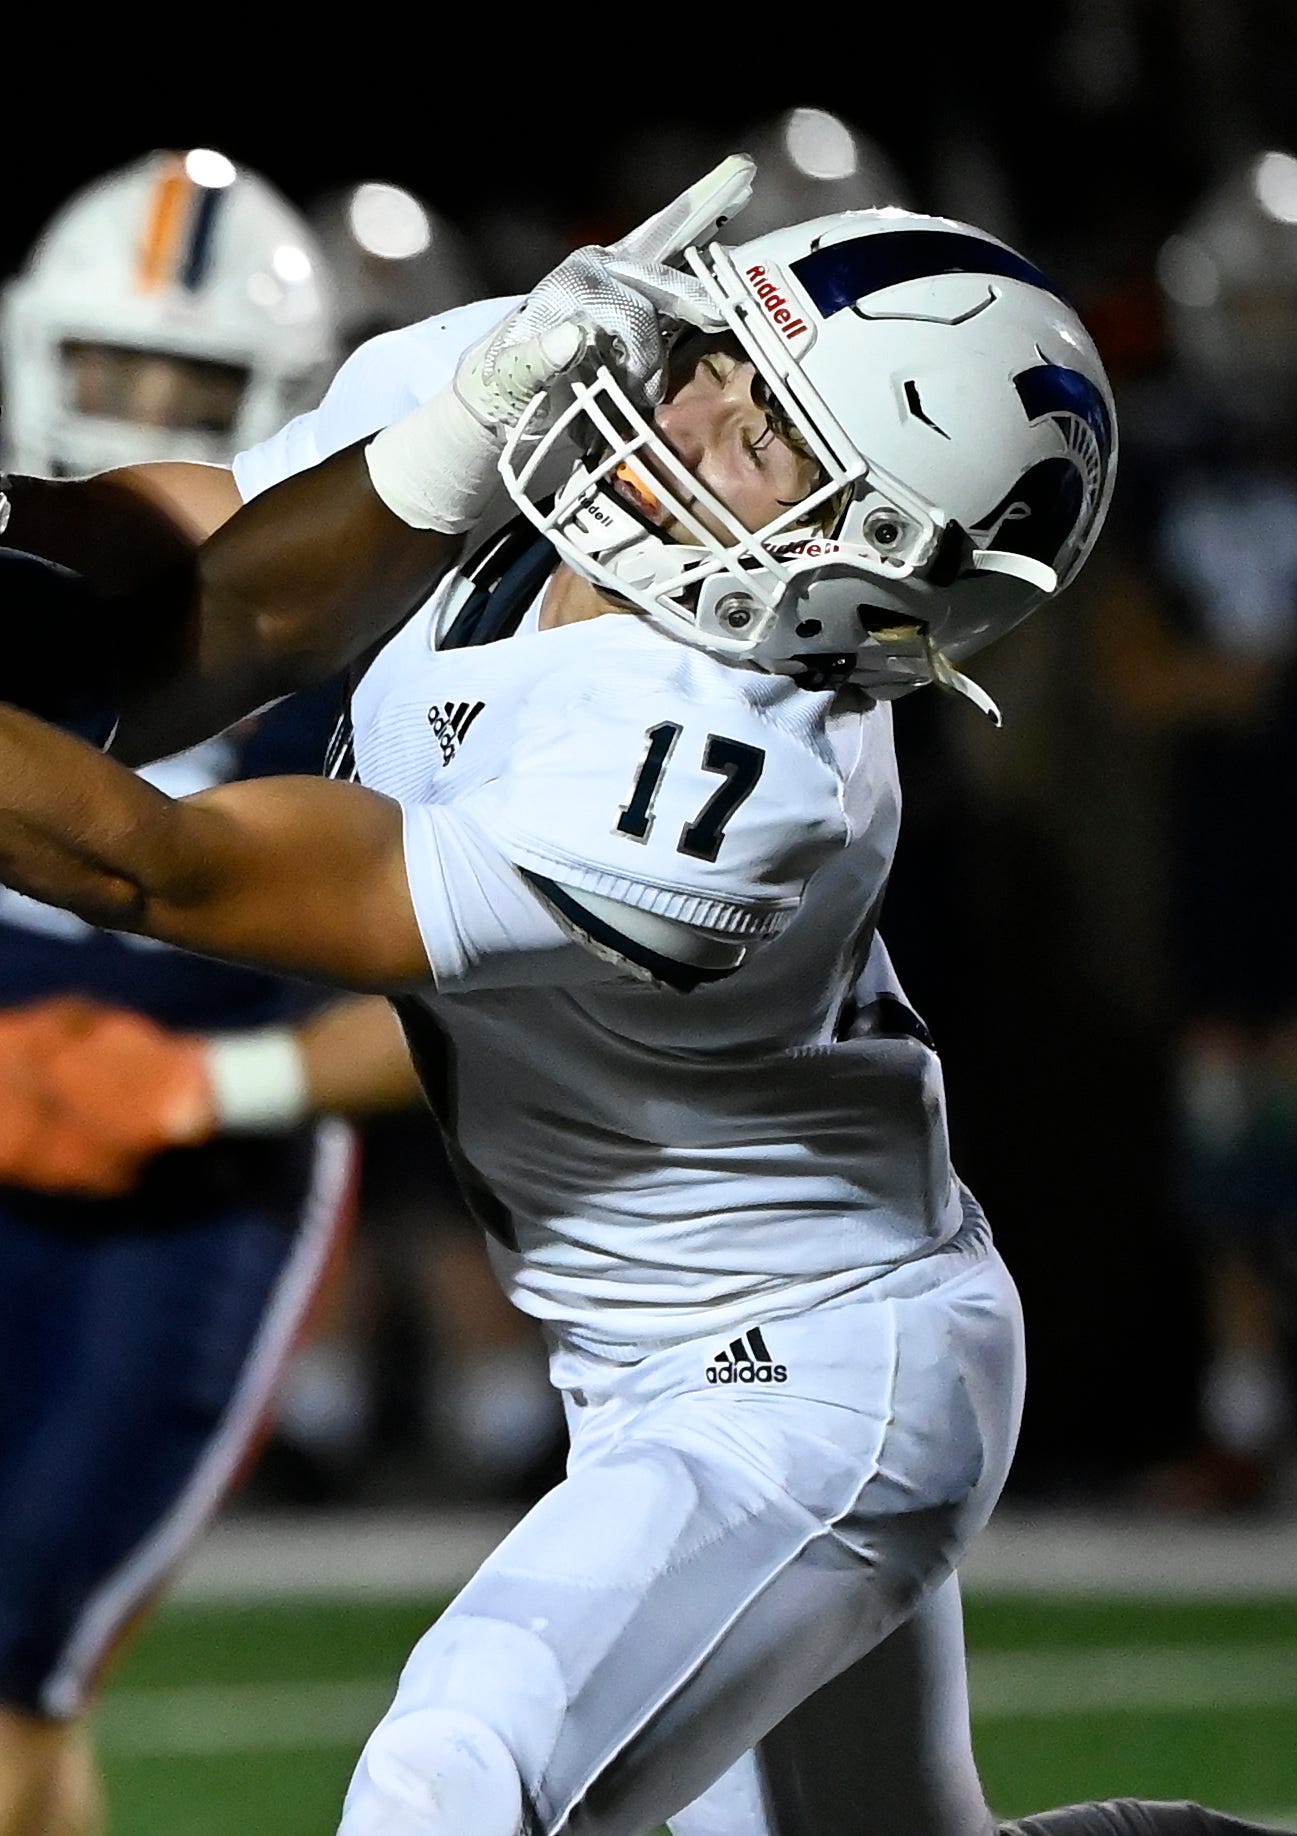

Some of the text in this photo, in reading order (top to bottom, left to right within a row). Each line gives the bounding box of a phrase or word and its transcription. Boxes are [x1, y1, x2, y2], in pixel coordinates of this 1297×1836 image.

[746, 265, 808, 340] Riddell
[609, 720, 766, 863] 17
[706, 1361, 788, 1384] adidas
